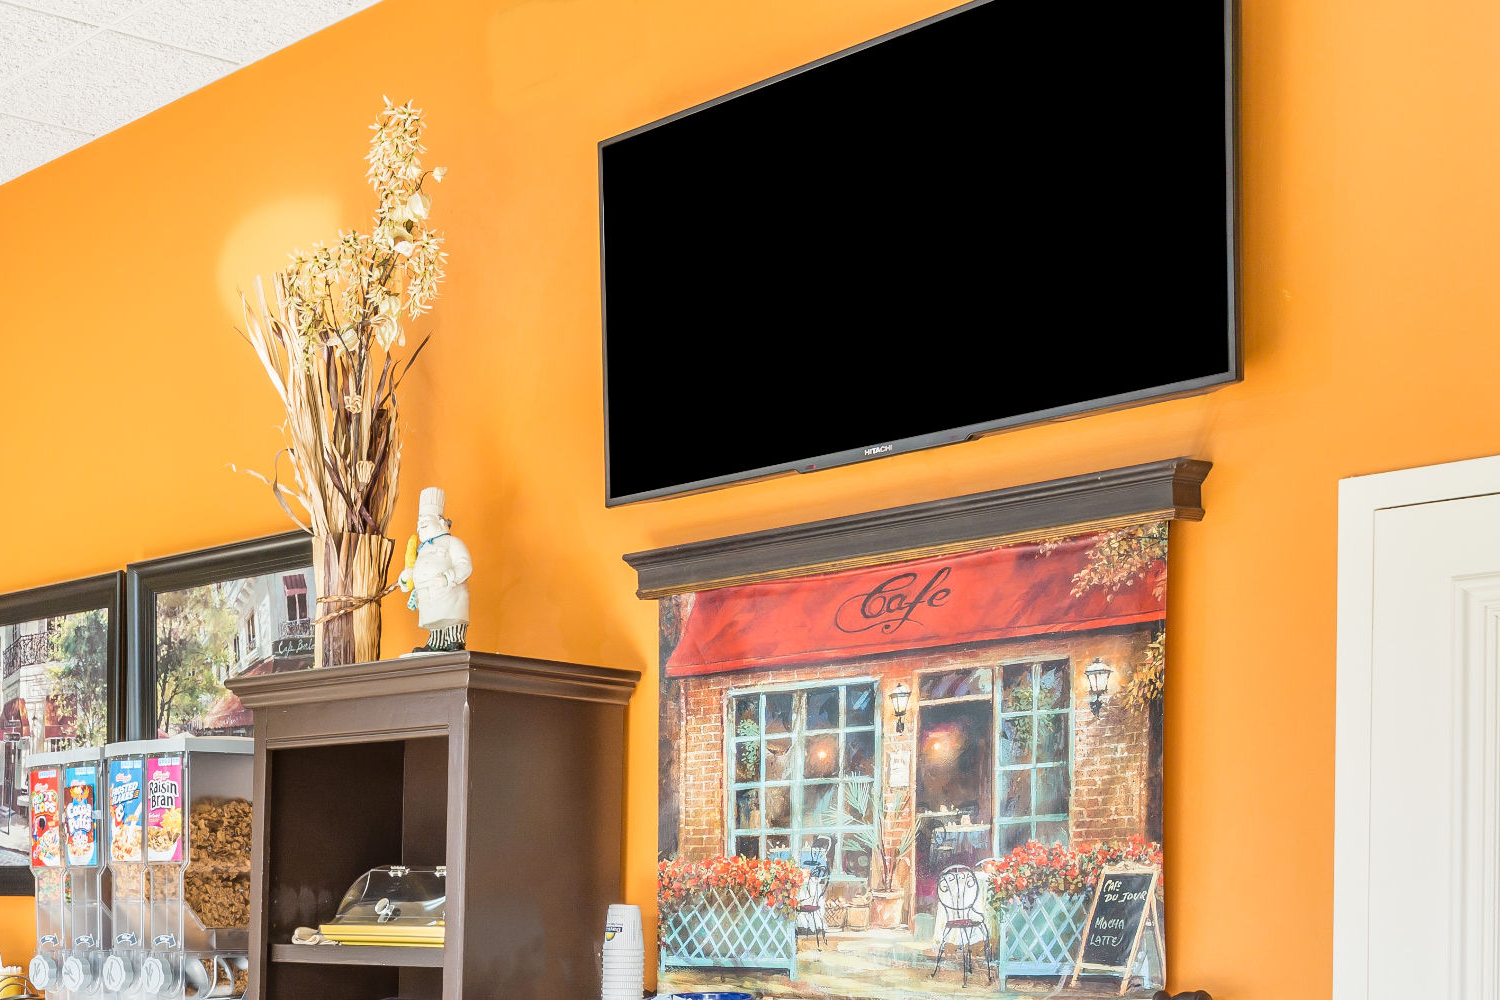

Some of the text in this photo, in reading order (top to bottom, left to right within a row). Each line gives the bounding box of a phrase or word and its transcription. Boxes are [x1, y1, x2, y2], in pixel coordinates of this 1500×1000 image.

[864, 444, 893, 456] HITACHI
[836, 566, 952, 635] Cafe
[149, 780, 177, 795] Raisin
[151, 794, 174, 808] Bran
[1104, 890, 1147, 903] DU JOUR
[1094, 916, 1125, 930] MOCHA
[1089, 934, 1123, 947] LATTE
